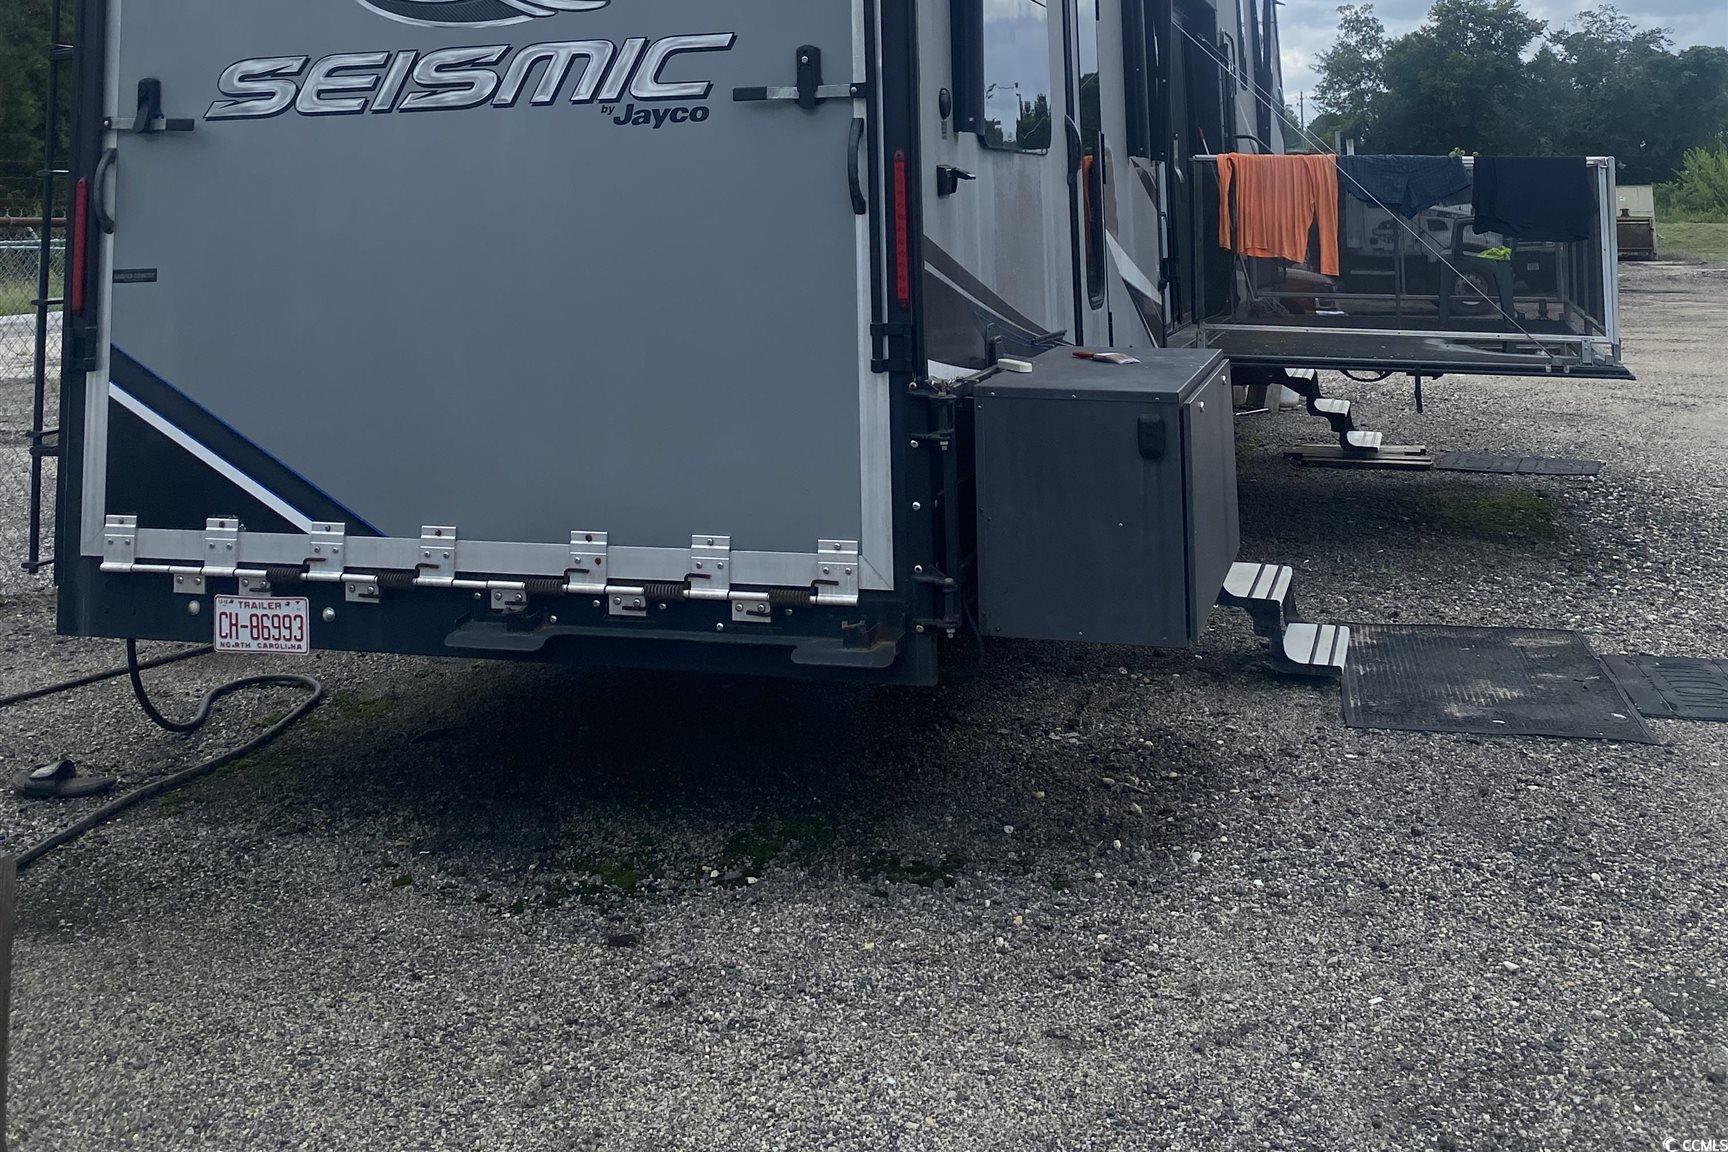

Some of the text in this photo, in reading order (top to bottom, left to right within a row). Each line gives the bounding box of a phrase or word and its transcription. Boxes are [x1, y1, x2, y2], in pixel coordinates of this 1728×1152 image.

[203, 32, 736, 121] SEISMIC
[600, 103, 710, 129] by Jayco
[238, 600, 282, 610] TRAILER
[218, 611, 305, 642] CH-86993
[219, 641, 303, 651] NORTH CAROLINA
